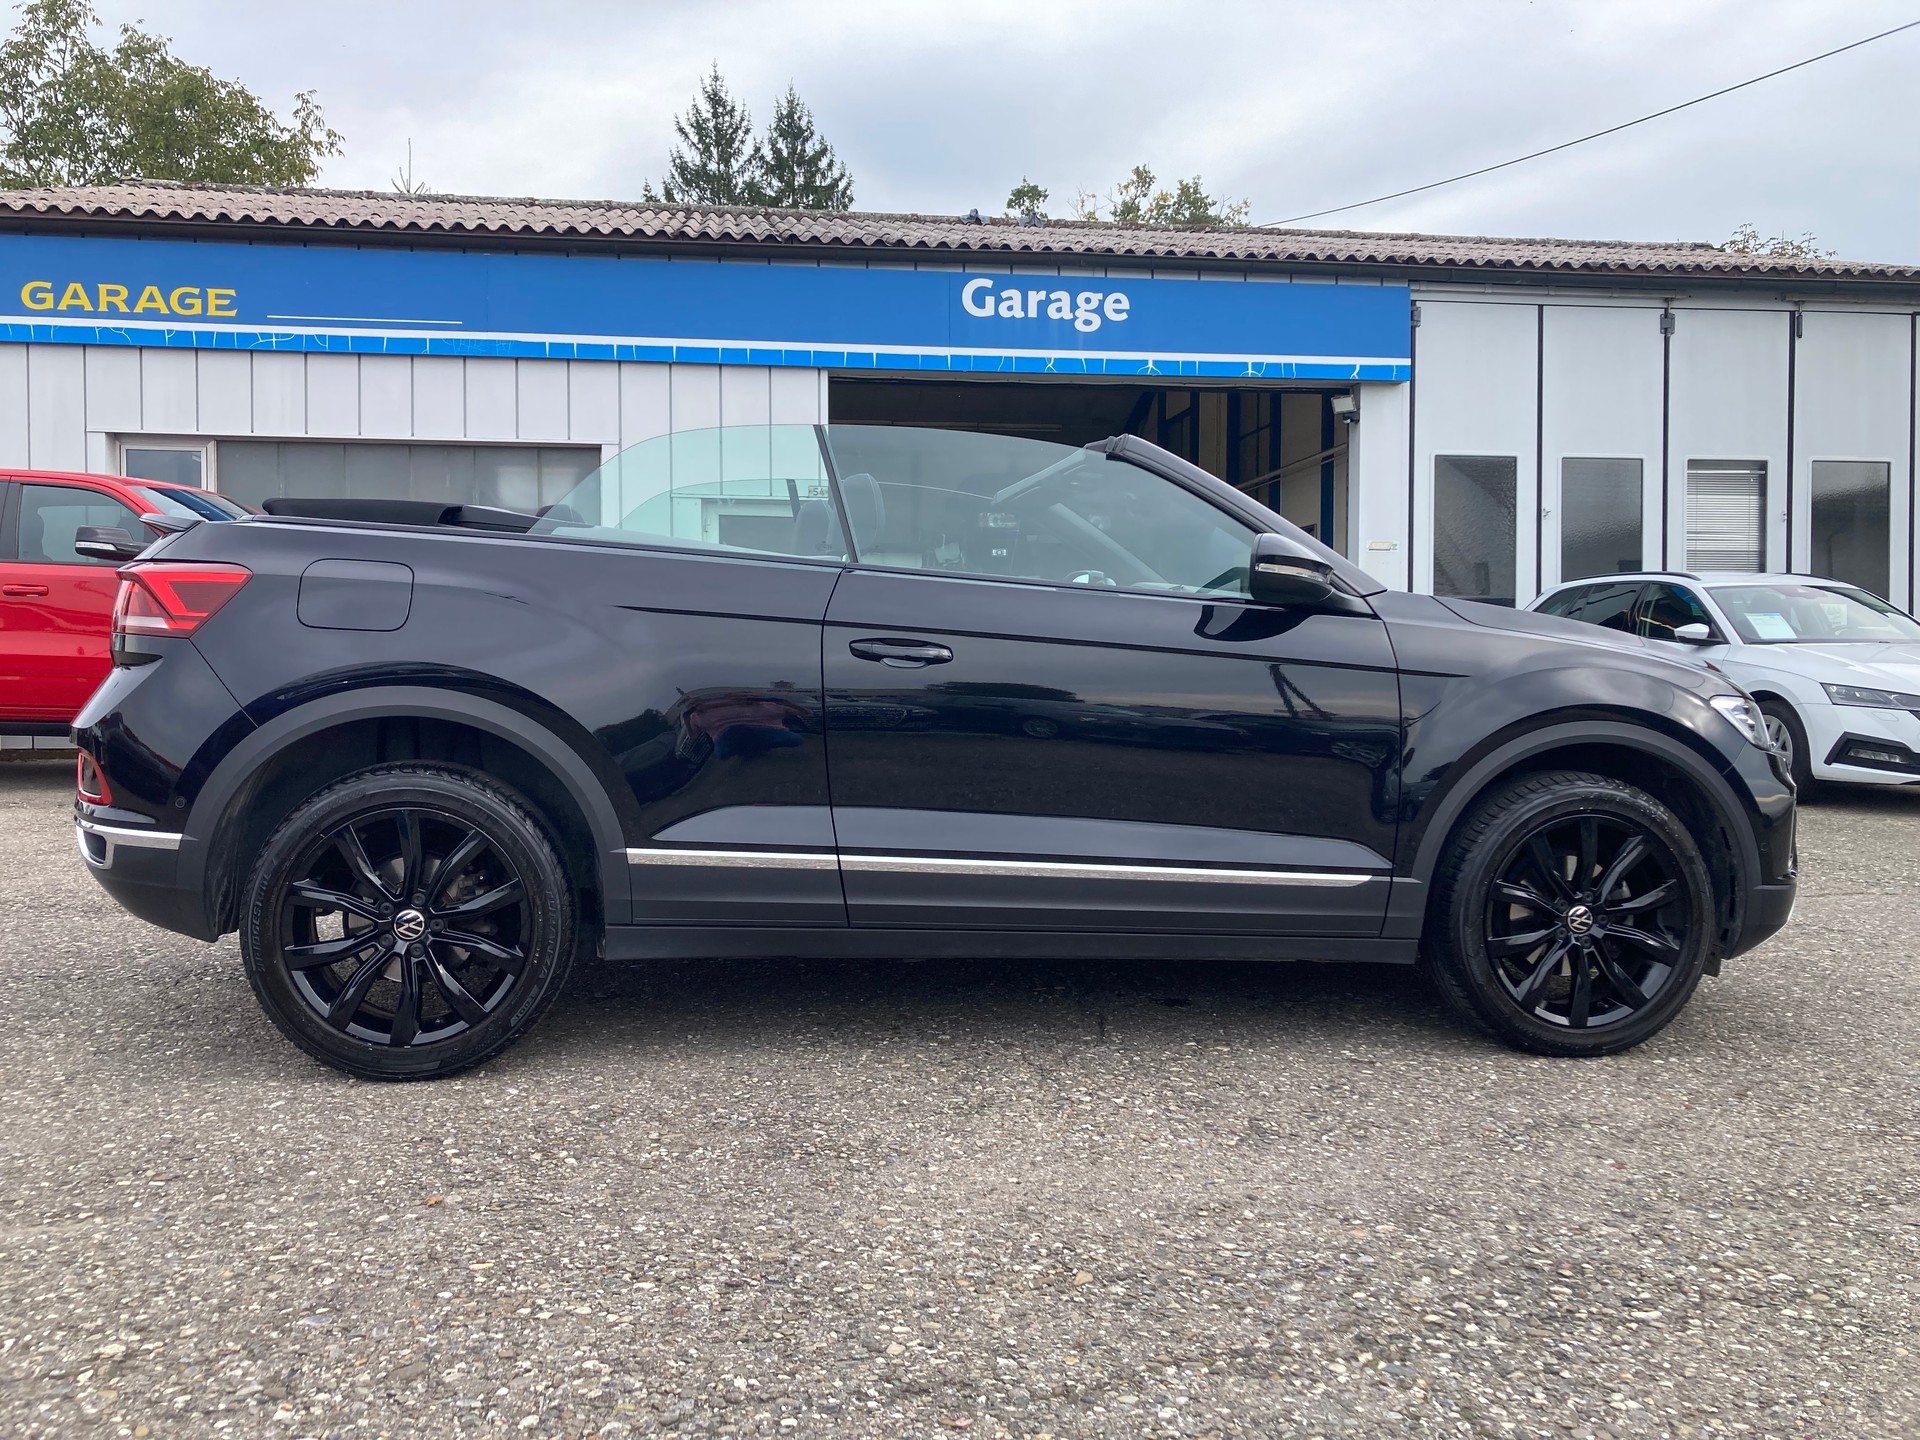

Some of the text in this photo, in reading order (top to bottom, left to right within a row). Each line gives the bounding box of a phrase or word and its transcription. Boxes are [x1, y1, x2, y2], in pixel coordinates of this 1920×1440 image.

[20, 281, 238, 317] GARAGE
[961, 278, 1130, 333] Garage
[253, 871, 271, 973] BRIDGESTONE
[394, 909, 425, 940] VW
